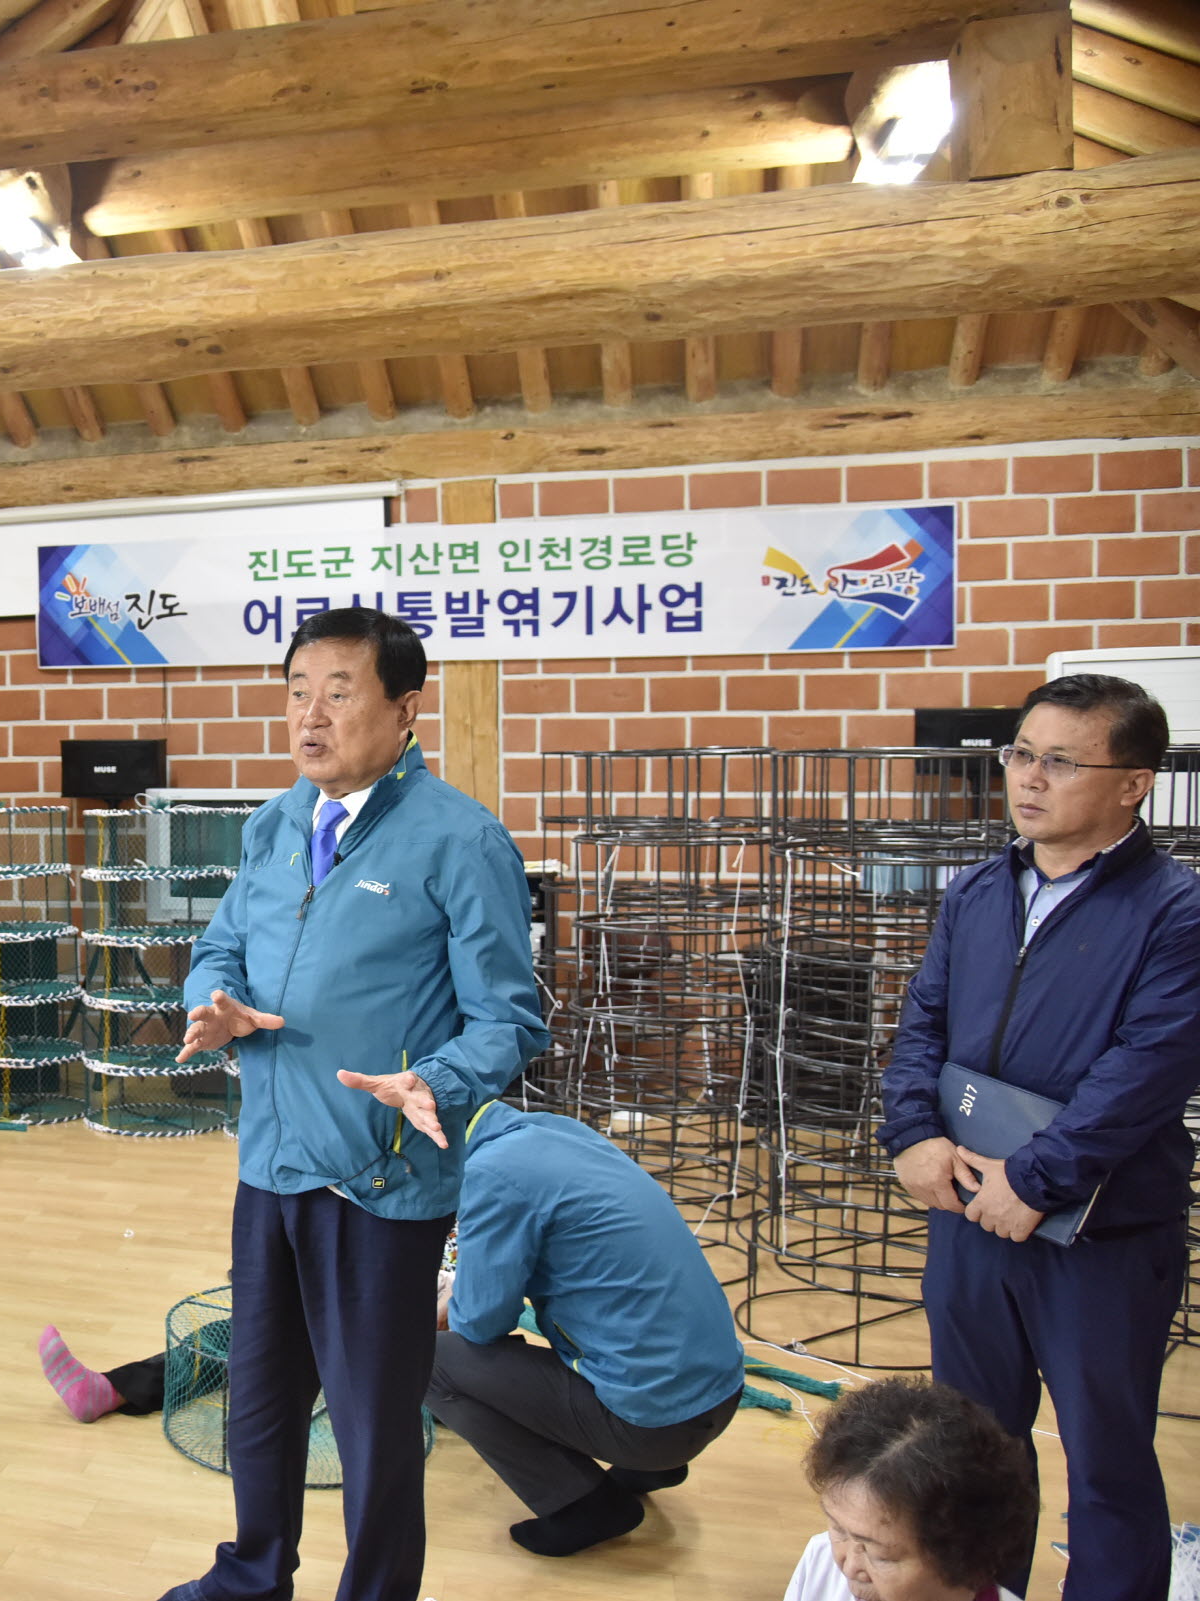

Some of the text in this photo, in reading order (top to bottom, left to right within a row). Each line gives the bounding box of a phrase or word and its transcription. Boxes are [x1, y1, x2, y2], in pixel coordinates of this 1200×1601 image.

[247, 532, 697, 582] 진도군 지산면 인천경로당
[69, 590, 188, 630] 보배섬 진도
[960, 738, 992, 747] MUSE
[93, 765, 117, 774] MUSE
[958, 1083, 978, 1117] 2017
